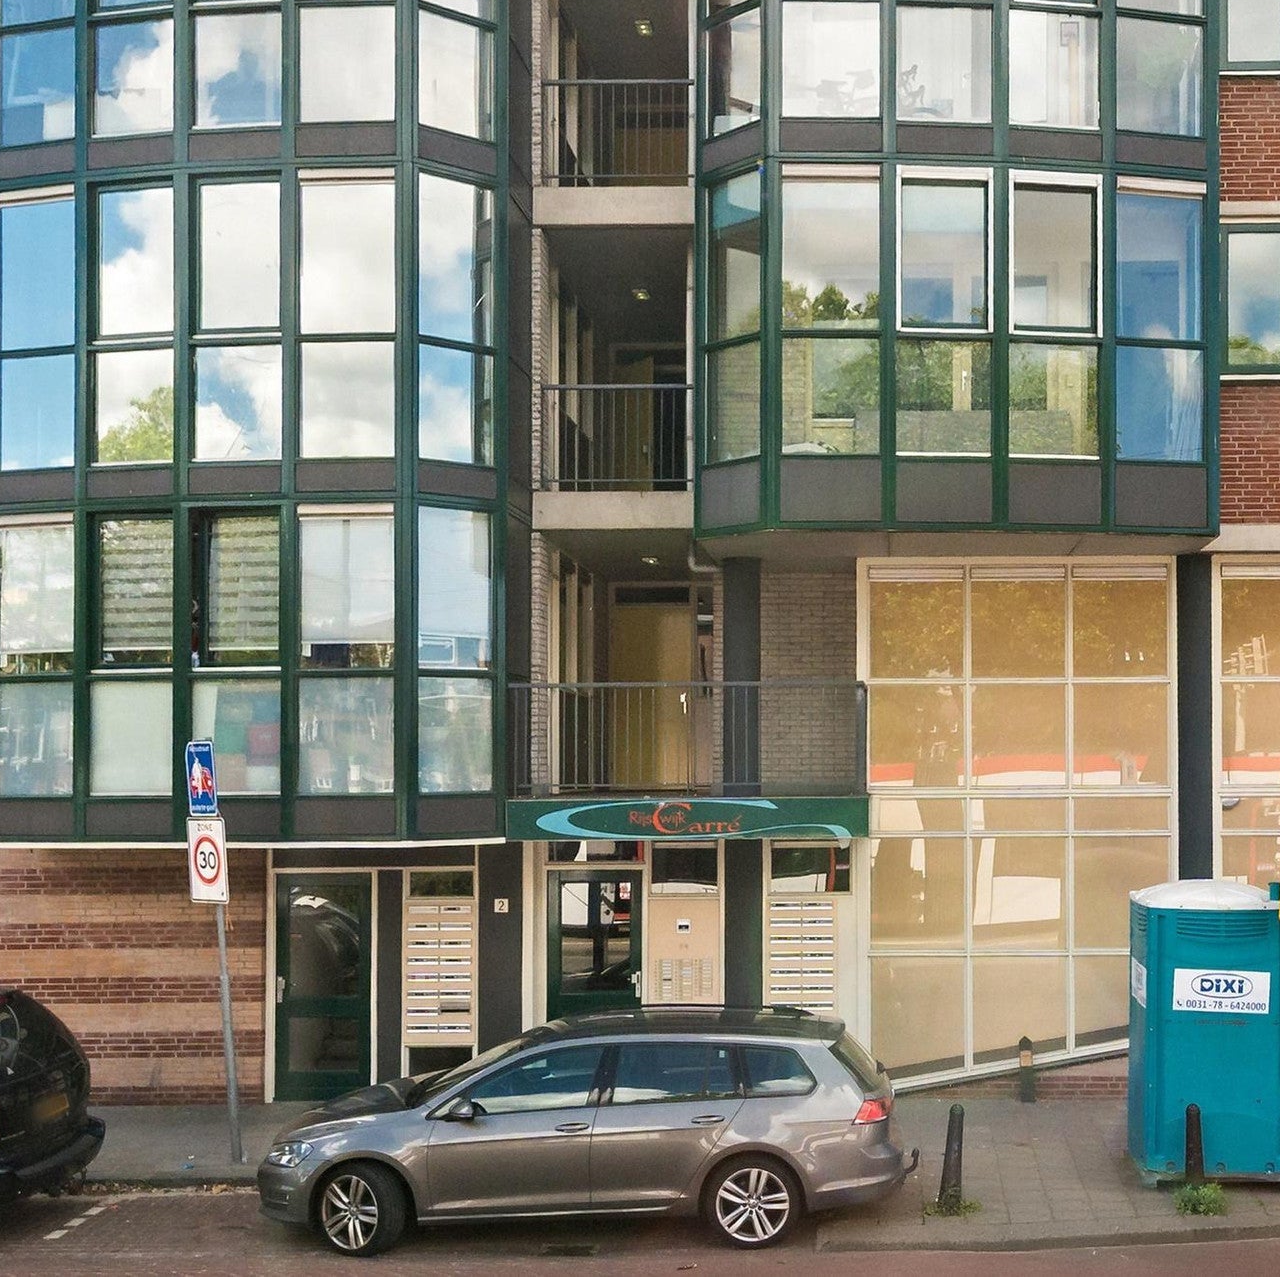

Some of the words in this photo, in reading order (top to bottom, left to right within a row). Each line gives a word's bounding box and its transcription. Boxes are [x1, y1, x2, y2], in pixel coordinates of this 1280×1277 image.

[652, 802, 742, 835] Carré
[200, 851, 216, 869] 30
[498, 899, 505, 911] 2
